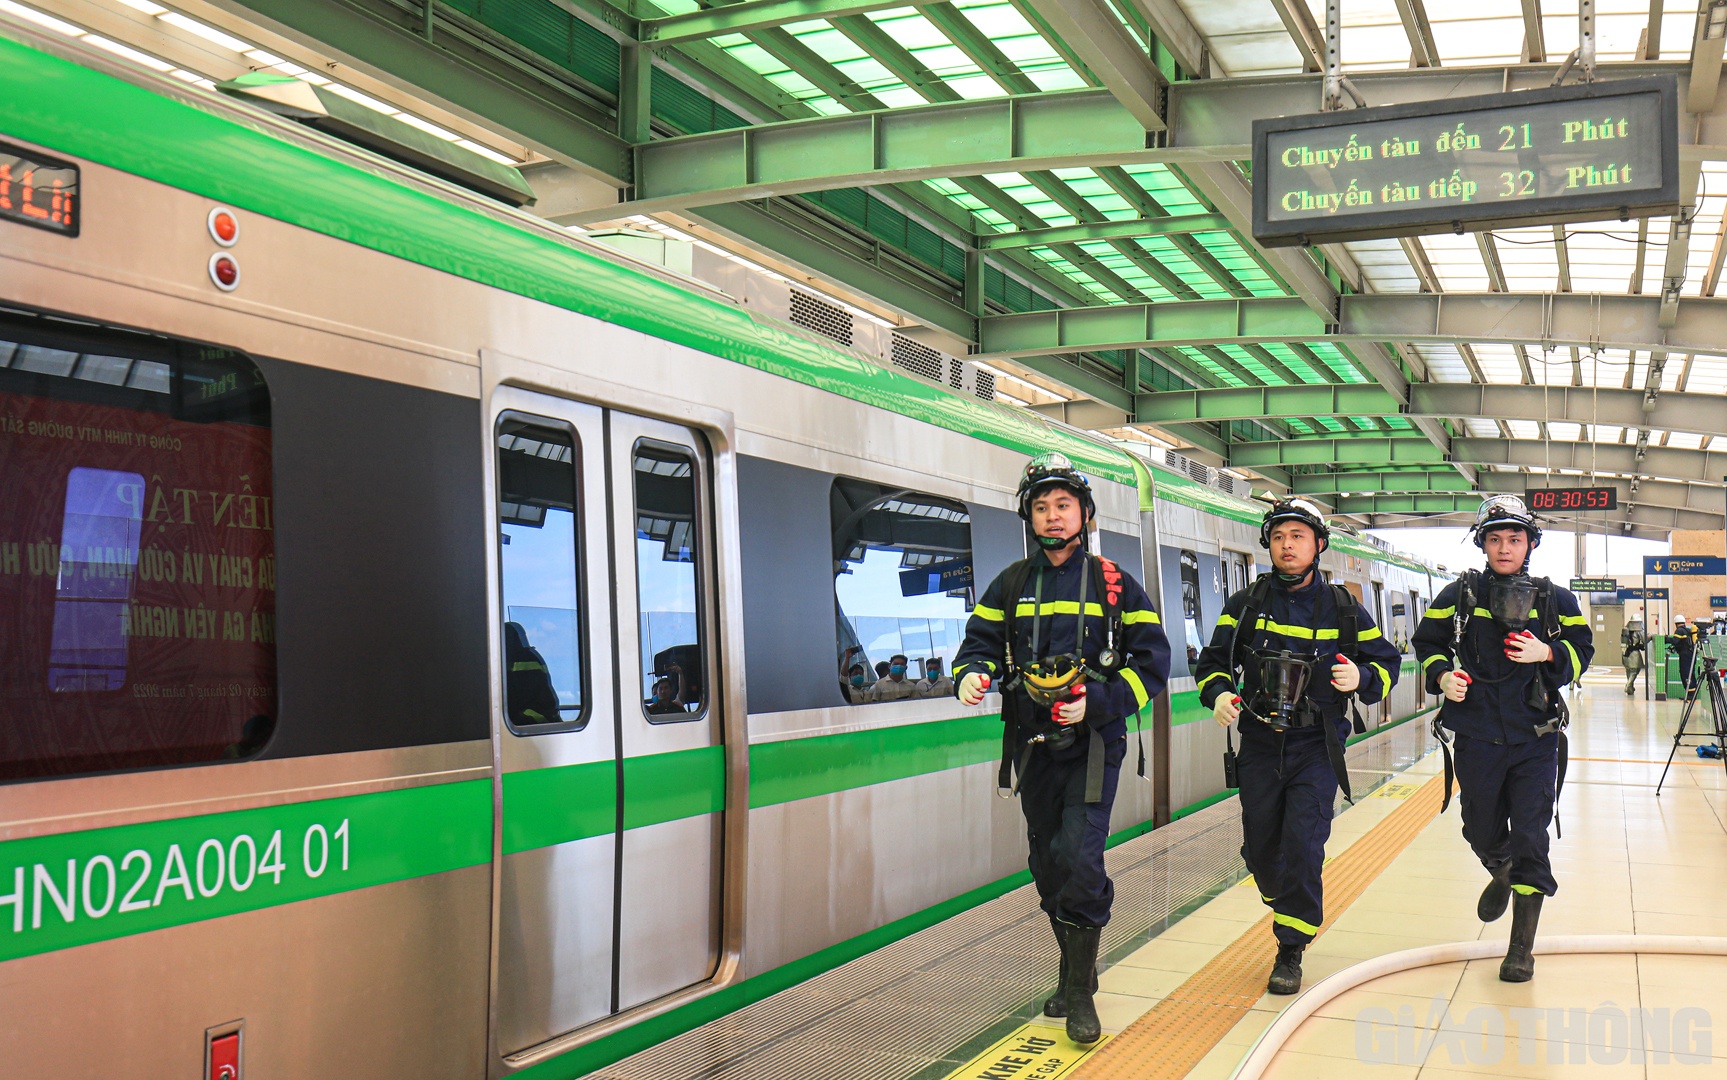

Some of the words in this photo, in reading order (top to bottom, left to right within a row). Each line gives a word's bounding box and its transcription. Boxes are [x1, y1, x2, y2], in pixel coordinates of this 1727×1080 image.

[1281, 133, 1373, 168] Chuyến
[1380, 137, 1420, 158] tàu
[1436, 122, 1481, 153] đến
[1498, 122, 1532, 151] 21
[1562, 117, 1628, 143] Phút
[1281, 178, 1373, 213] Chuyến
[1381, 182, 1421, 203] tàu
[1428, 169, 1478, 202] tiếp
[1499, 169, 1535, 197] 32
[1565, 163, 1632, 189] Phút
[1533, 491, 1609, 508] 08:30:53
[303, 818, 349, 878] 01
[1036, 1058, 1064, 1074] GAP
